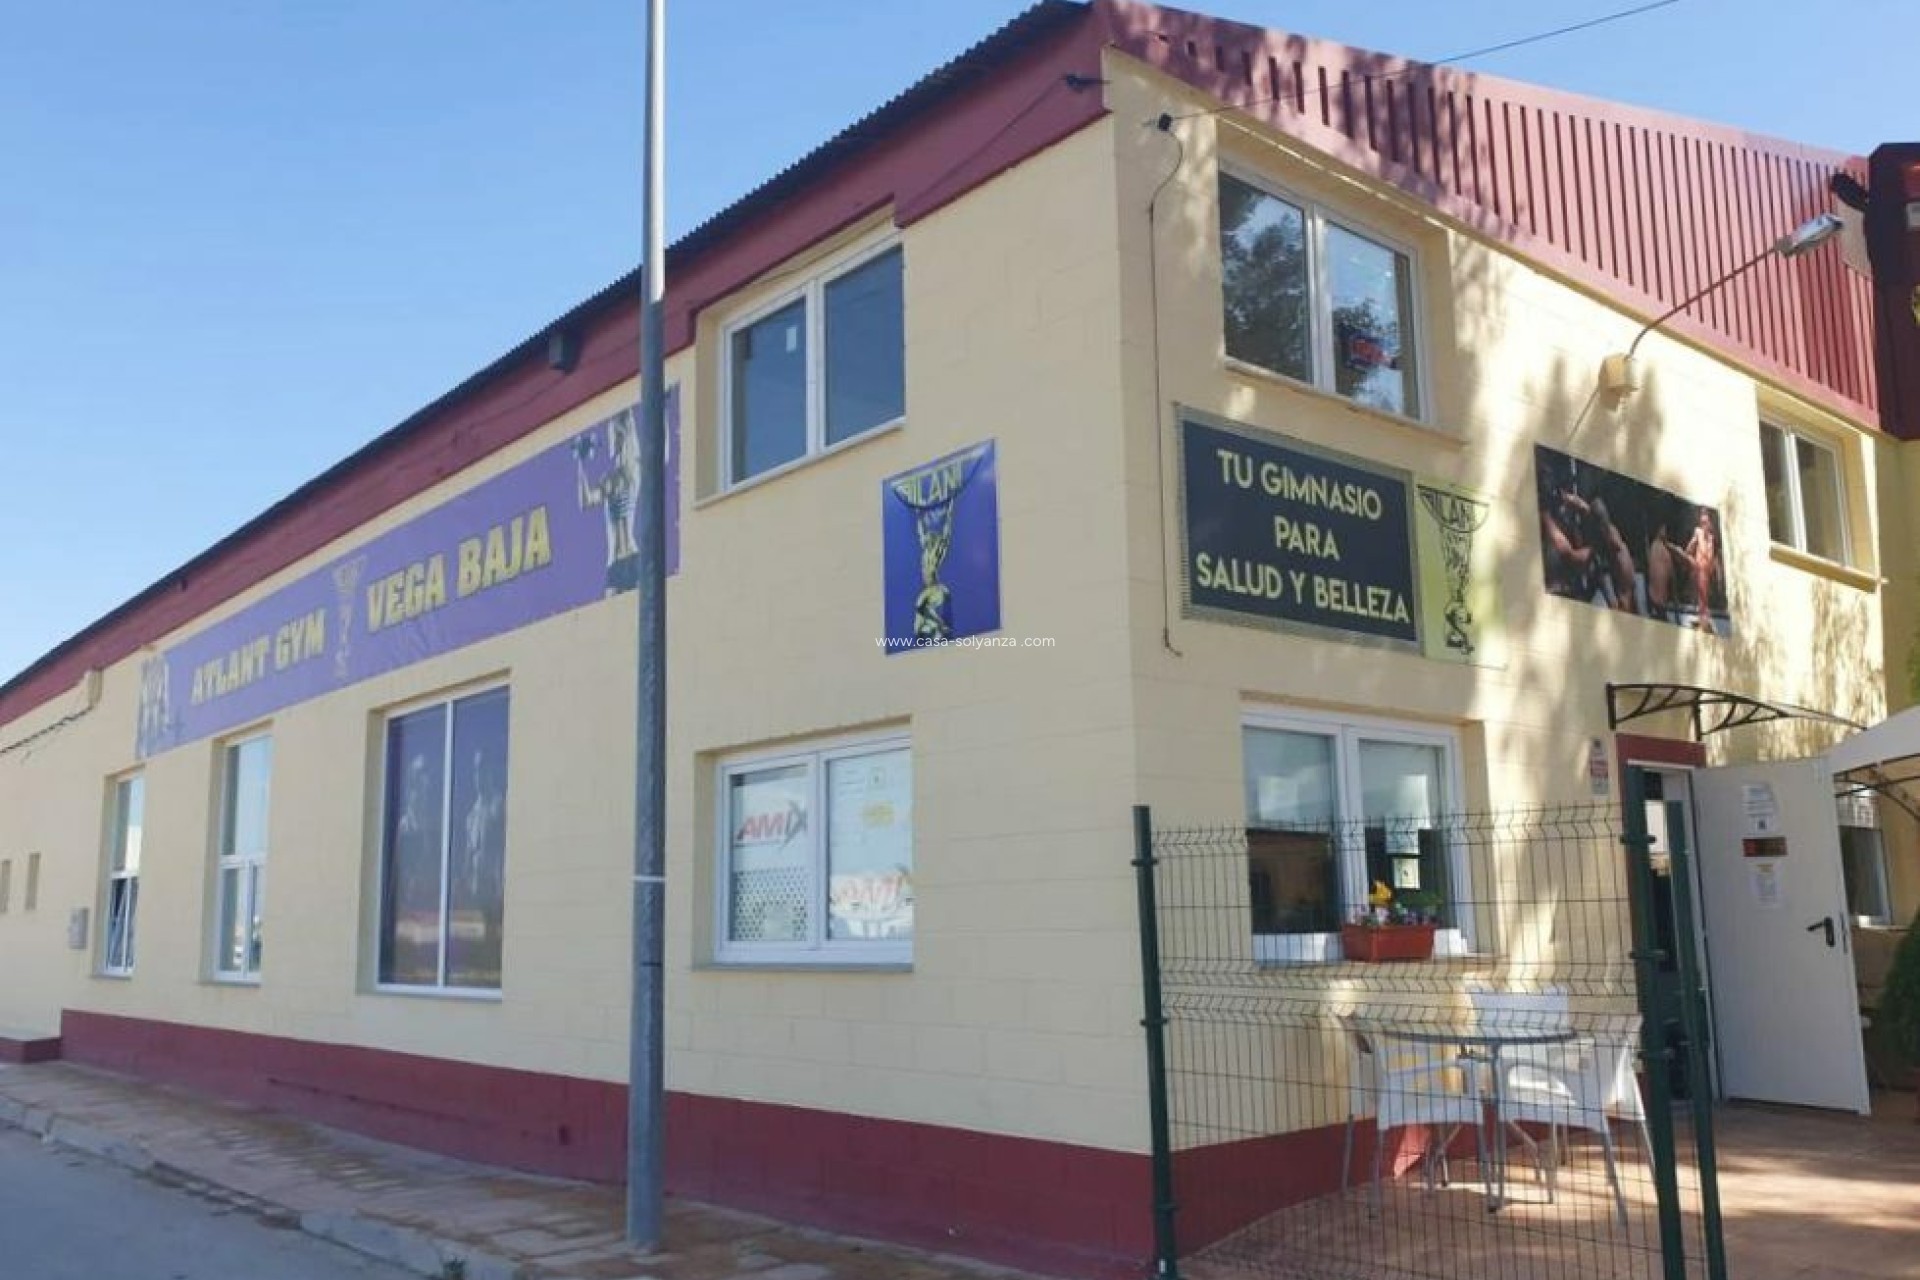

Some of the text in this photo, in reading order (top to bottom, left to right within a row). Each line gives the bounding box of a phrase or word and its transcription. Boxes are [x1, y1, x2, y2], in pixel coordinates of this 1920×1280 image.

[1216, 449, 1254, 489] TU
[1260, 461, 1382, 520] GIMNASIO
[1273, 514, 1341, 562] PARA
[191, 504, 552, 706] ATLANT GYM VEGA BAJA
[1195, 551, 1411, 625] SALUD Y BELLEZA
